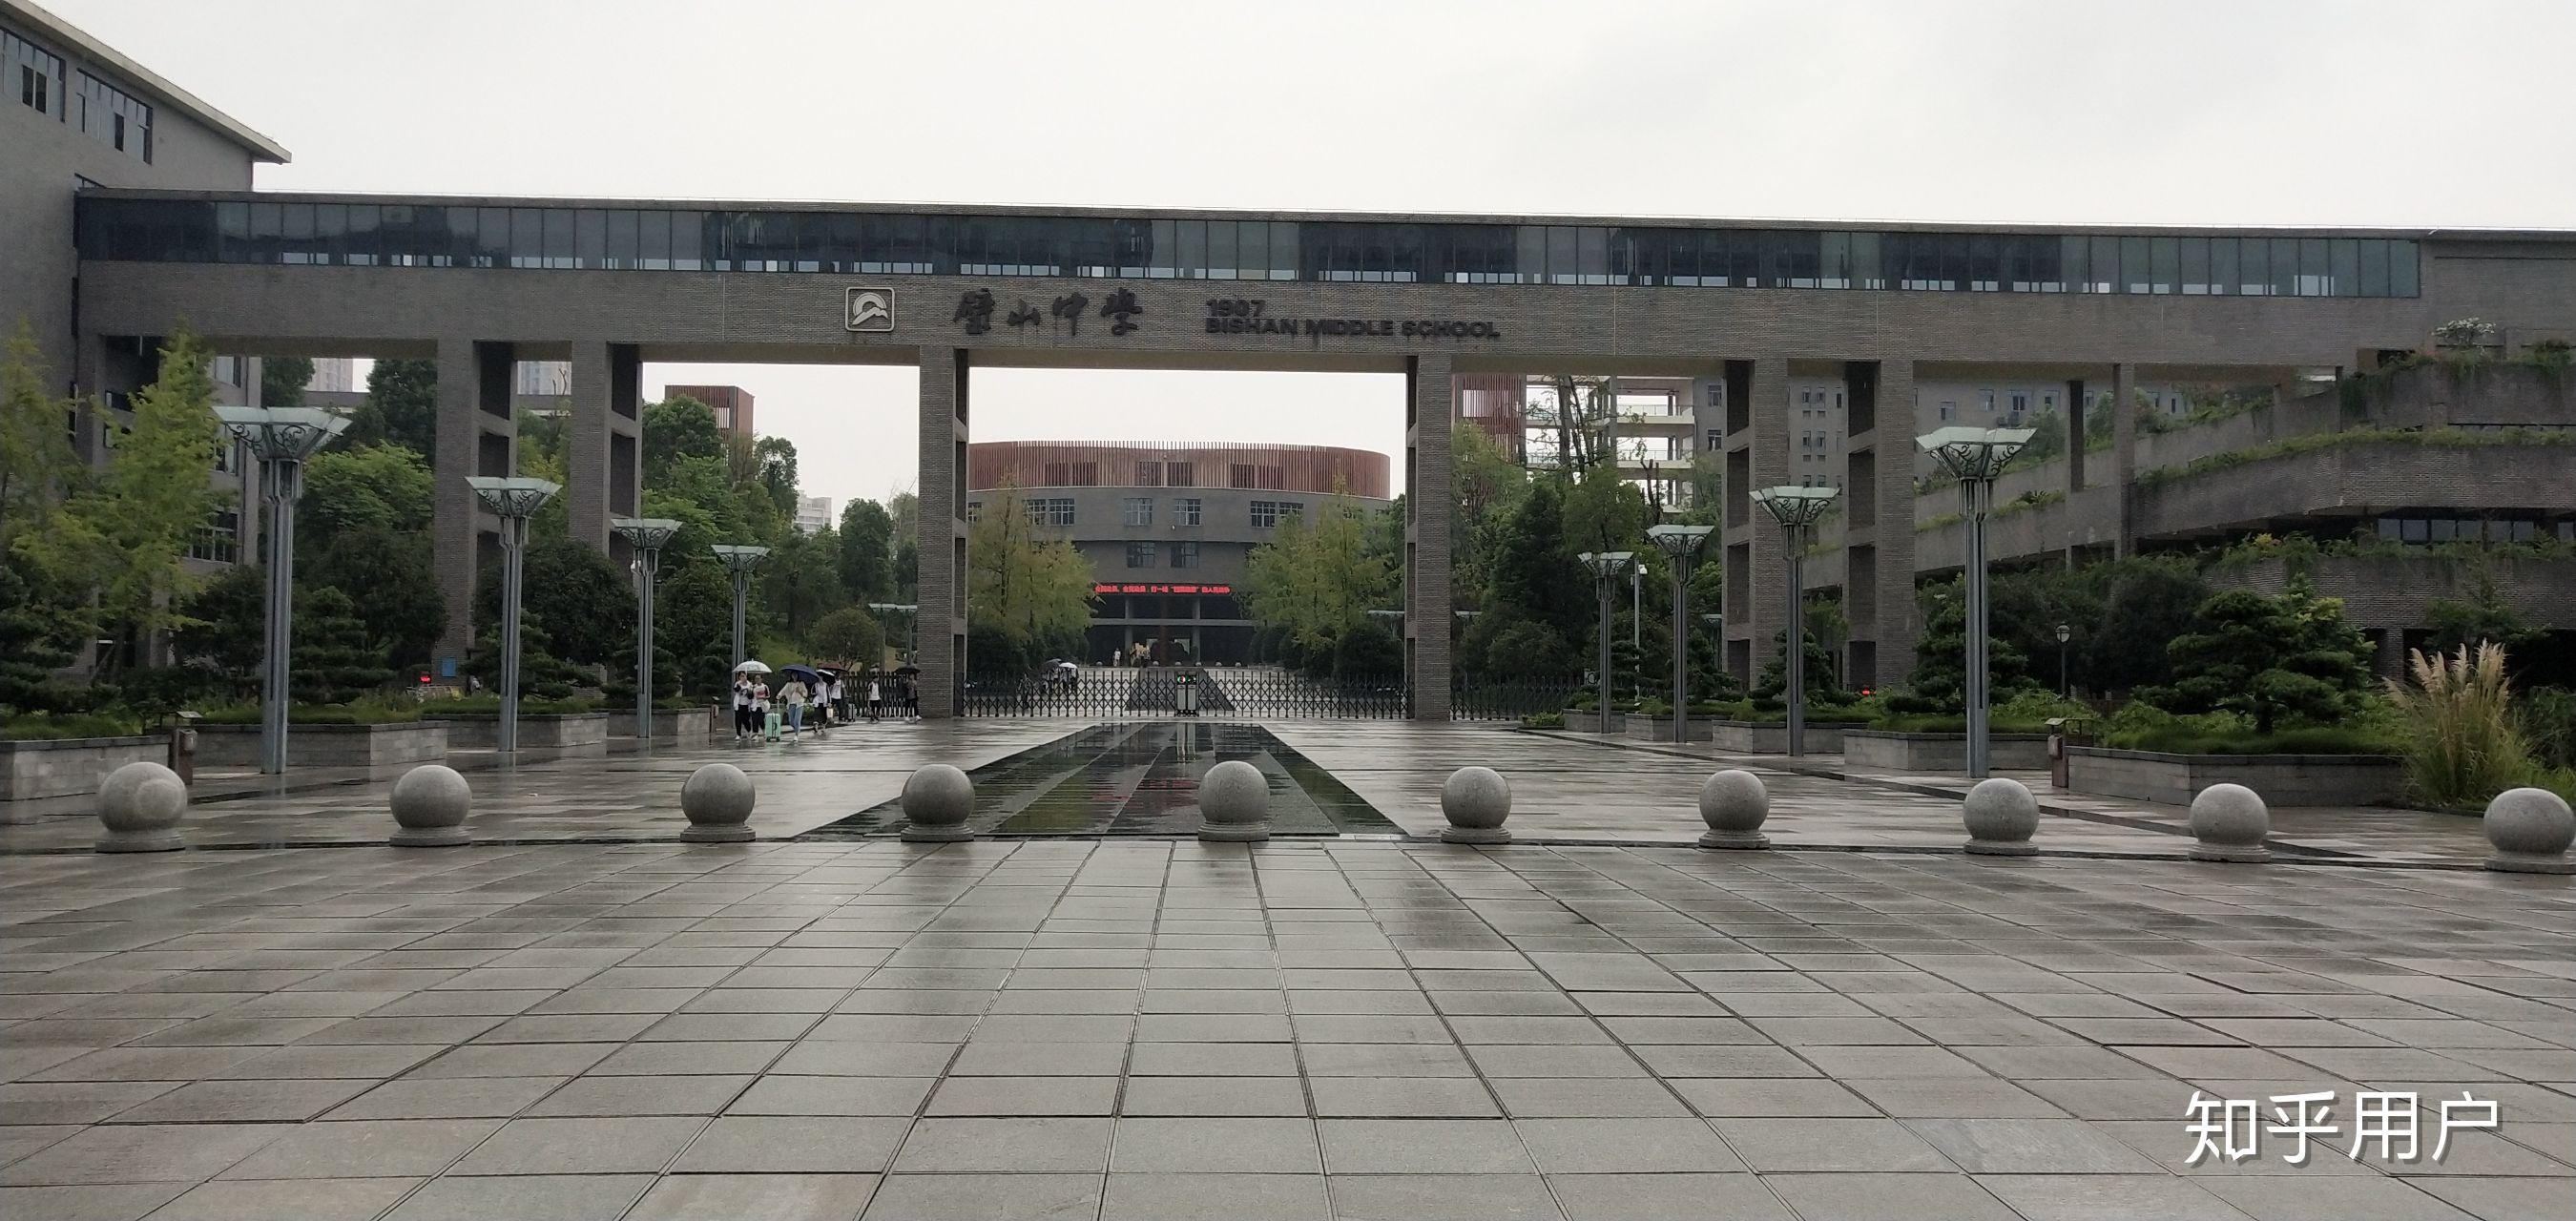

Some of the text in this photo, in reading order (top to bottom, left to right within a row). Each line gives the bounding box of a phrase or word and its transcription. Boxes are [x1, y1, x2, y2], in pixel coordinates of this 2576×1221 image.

[1206, 299, 1266, 318] 1907
[1205, 318, 1501, 338] BISHAN MIDDLE SCHOOL
